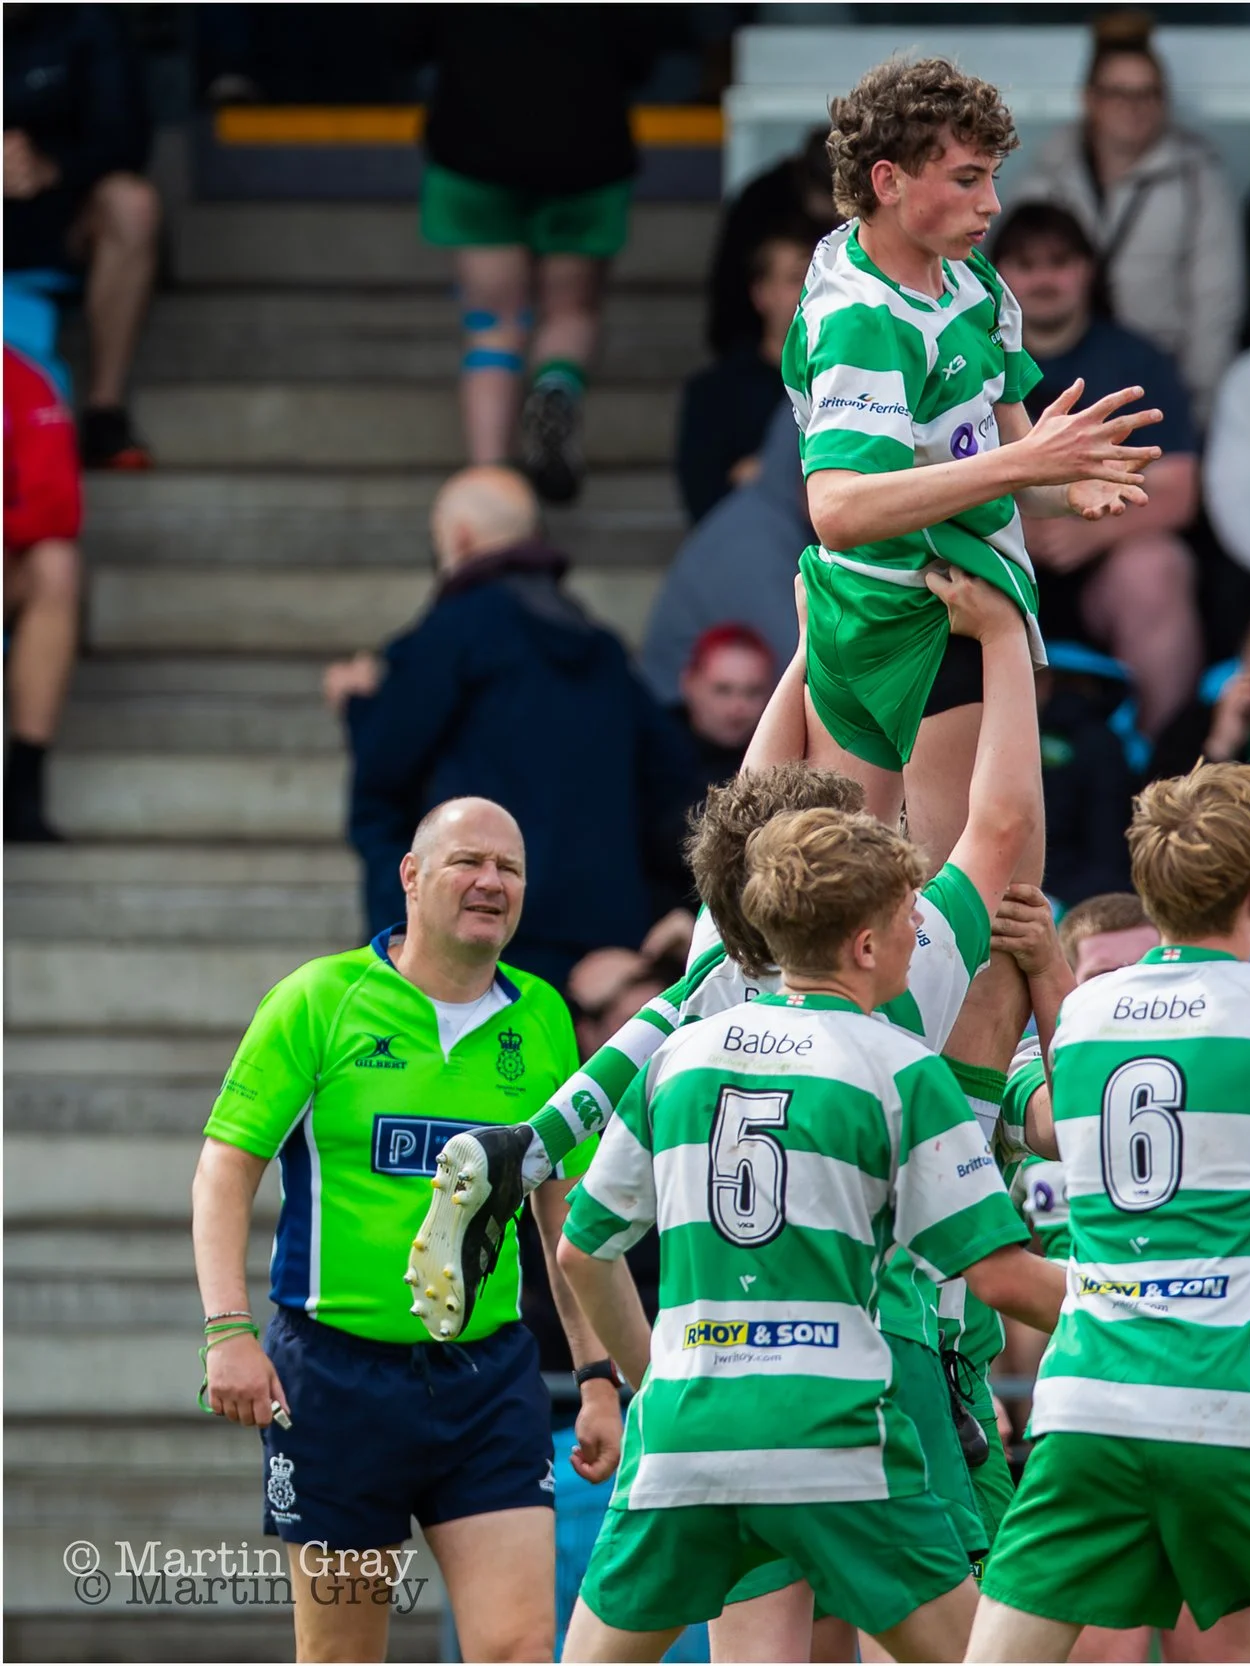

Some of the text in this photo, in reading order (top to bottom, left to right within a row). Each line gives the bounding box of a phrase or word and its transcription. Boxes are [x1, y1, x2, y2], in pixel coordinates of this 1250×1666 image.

[818, 396, 909, 417] Brittany Ferries
[1113, 993, 1207, 1021] Babbé
[723, 1025, 814, 1057] Babbé
[355, 1058, 407, 1070] GILBERT
[1100, 1054, 1188, 1214] 6
[708, 1084, 794, 1249] 5
[957, 1156, 993, 1178] Britta
[1168, 1278, 1225, 1297] SON
[687, 1323, 834, 1346] RHOY & SON
